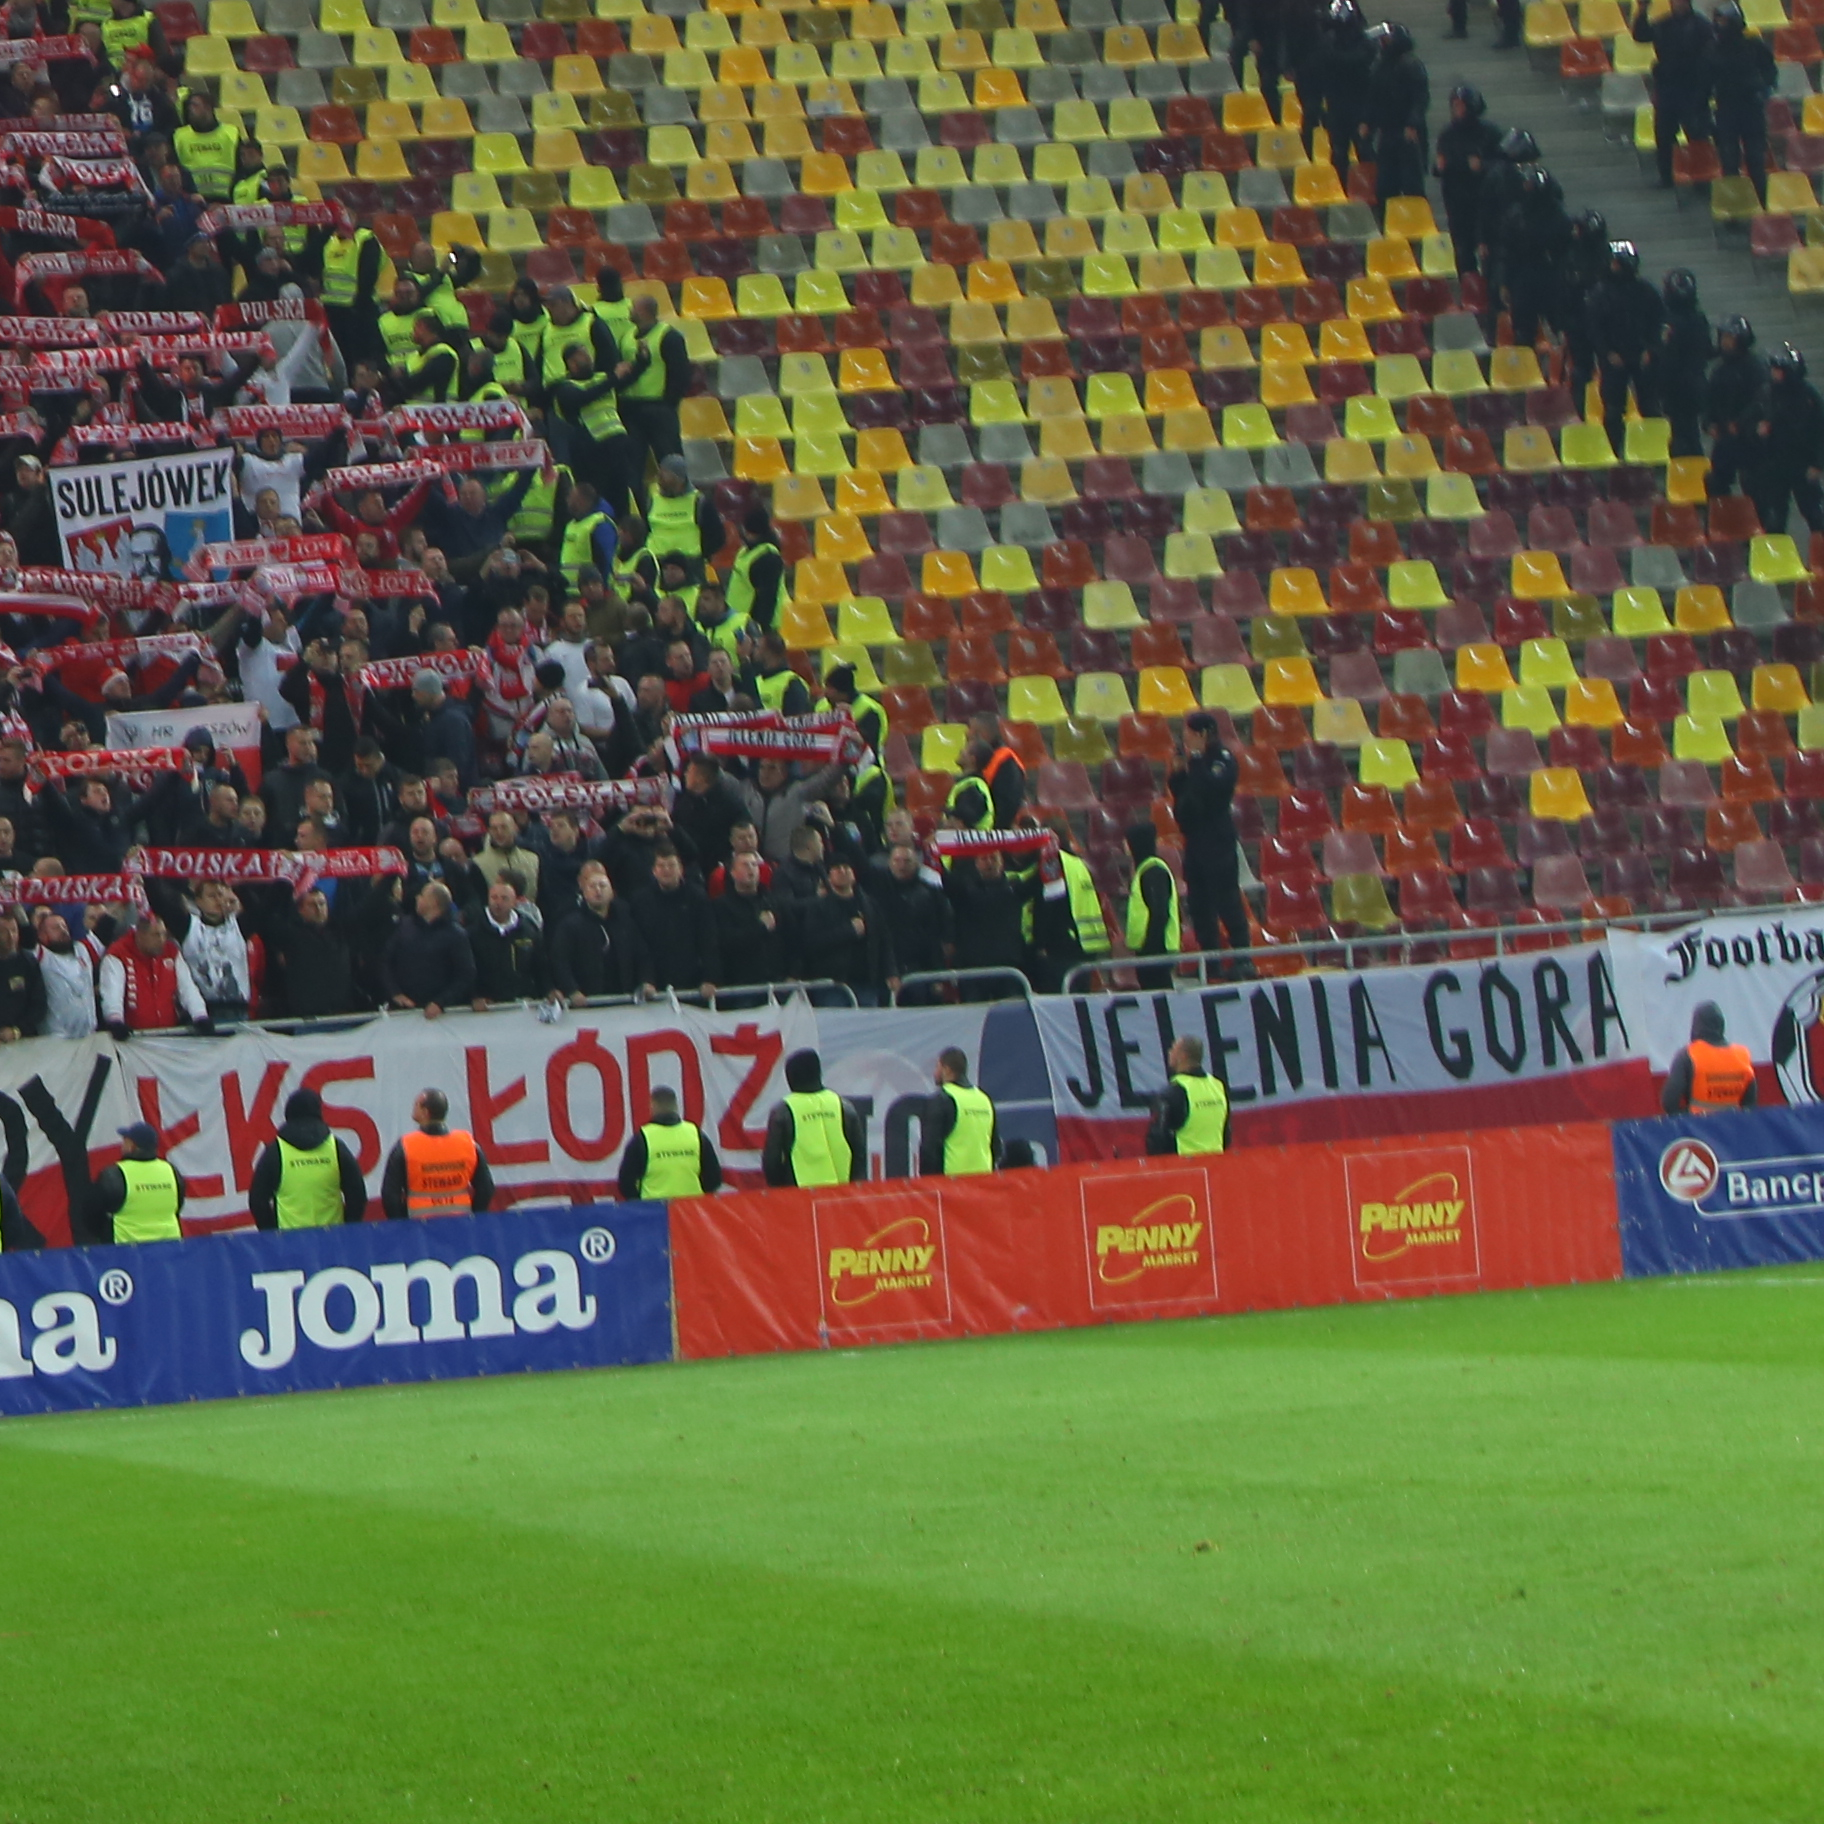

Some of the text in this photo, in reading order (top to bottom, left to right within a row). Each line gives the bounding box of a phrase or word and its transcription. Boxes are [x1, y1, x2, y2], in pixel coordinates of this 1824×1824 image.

[16, 207, 78, 240] POLSKA
[240, 300, 306, 321] POLSKA
[58, 460, 228, 520] SULEJÓWEK
[55, 750, 169, 776] POLSKA
[499, 781, 659, 812] POLSKA
[157, 850, 266, 883] POLSKA
[27, 876, 136, 903] POLSKA
[1069, 950, 1632, 1109] JELENIA GÓRA
[138, 1052, 383, 1232] ŁKS
[464, 1024, 797, 1186] ŁÓDŹ
[290, 1157, 331, 1169] STEWARD
[656, 1149, 695, 1159] STEWARD
[135, 1183, 172, 1192] STEWARD
[1359, 1200, 1465, 1233] PENNY
[1096, 1222, 1202, 1254] PENNY
[1405, 1229, 1461, 1247] MARKET
[829, 1245, 936, 1277] PENNY
[1142, 1250, 1199, 1268] MARKET
[875, 1274, 933, 1291] MARKET
